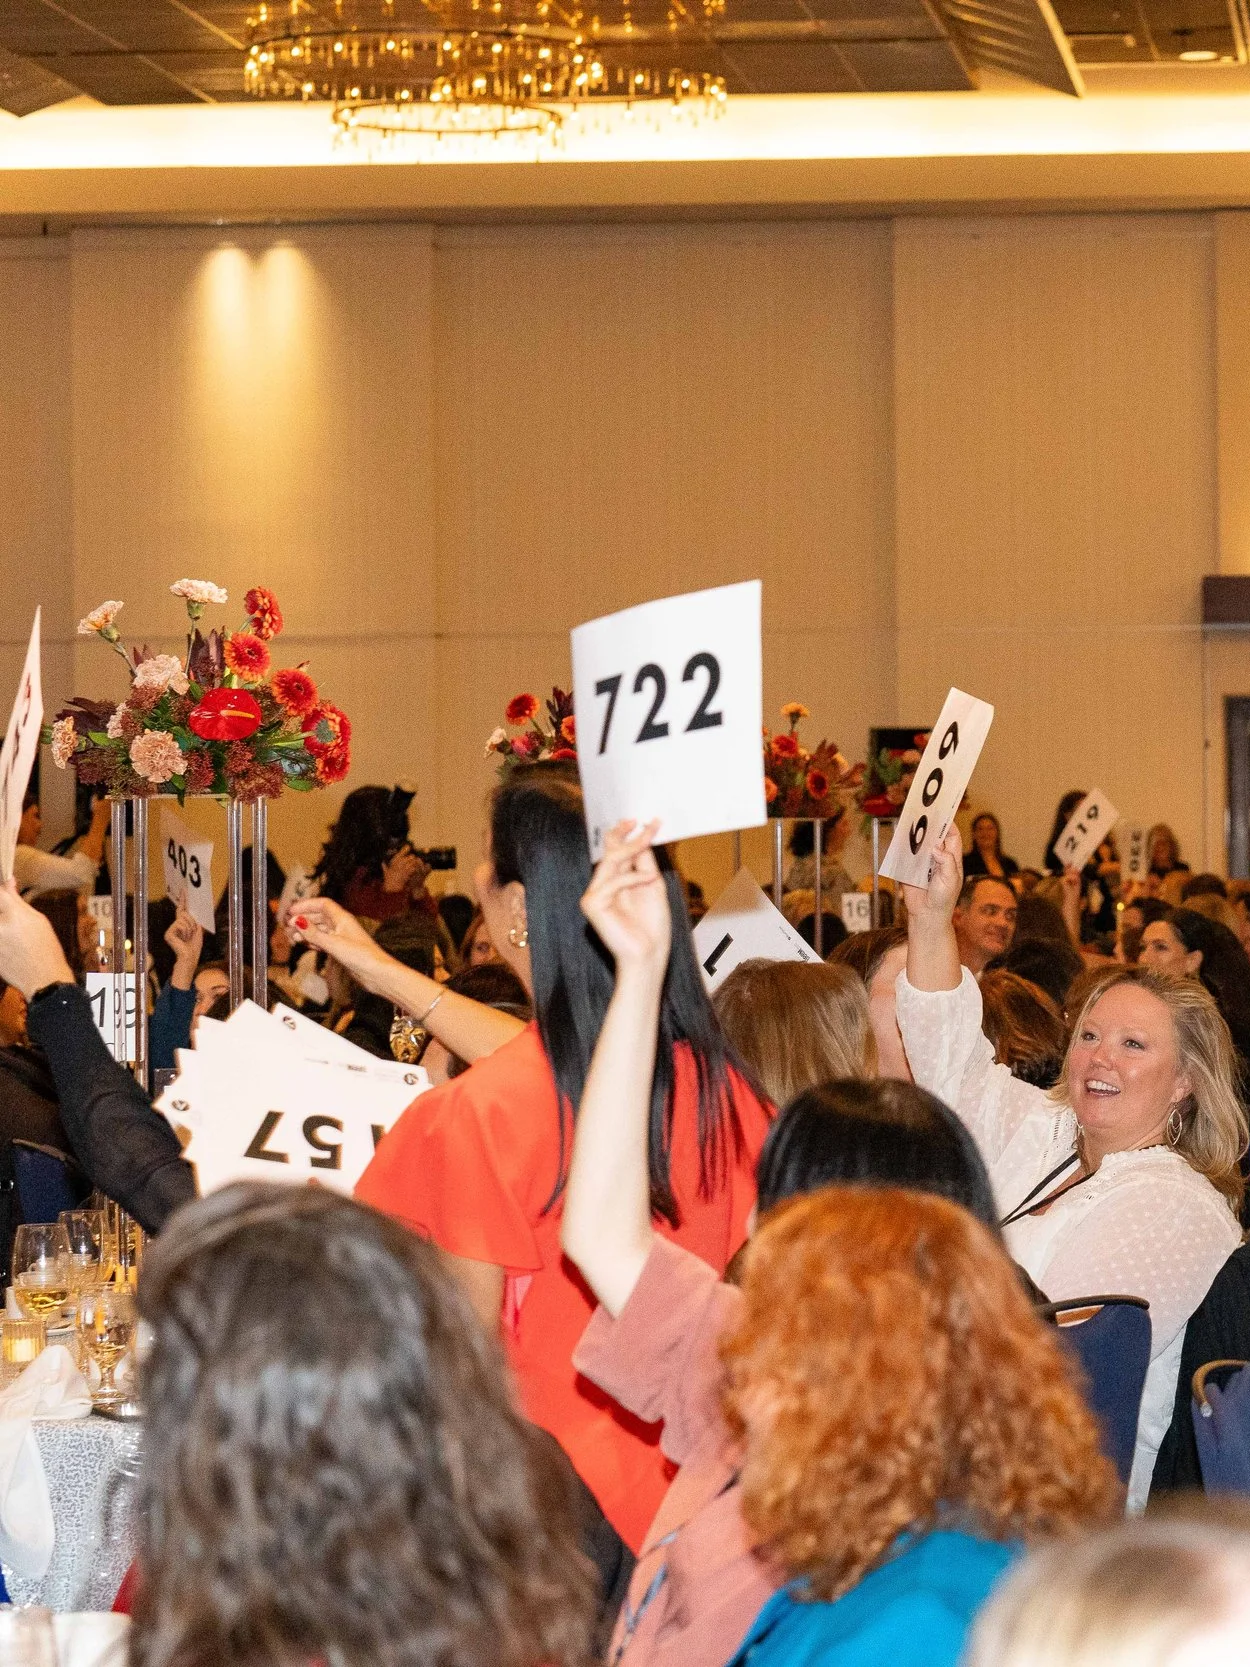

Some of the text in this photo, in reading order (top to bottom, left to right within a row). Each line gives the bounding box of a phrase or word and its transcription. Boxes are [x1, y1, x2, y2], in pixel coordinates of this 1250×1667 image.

[595, 652, 723, 755] 722
[909, 721, 959, 855] 609
[1065, 804, 1099, 852] 219
[168, 838, 201, 888] 403
[846, 900, 868, 918] 16
[243, 1109, 385, 1170] 57
